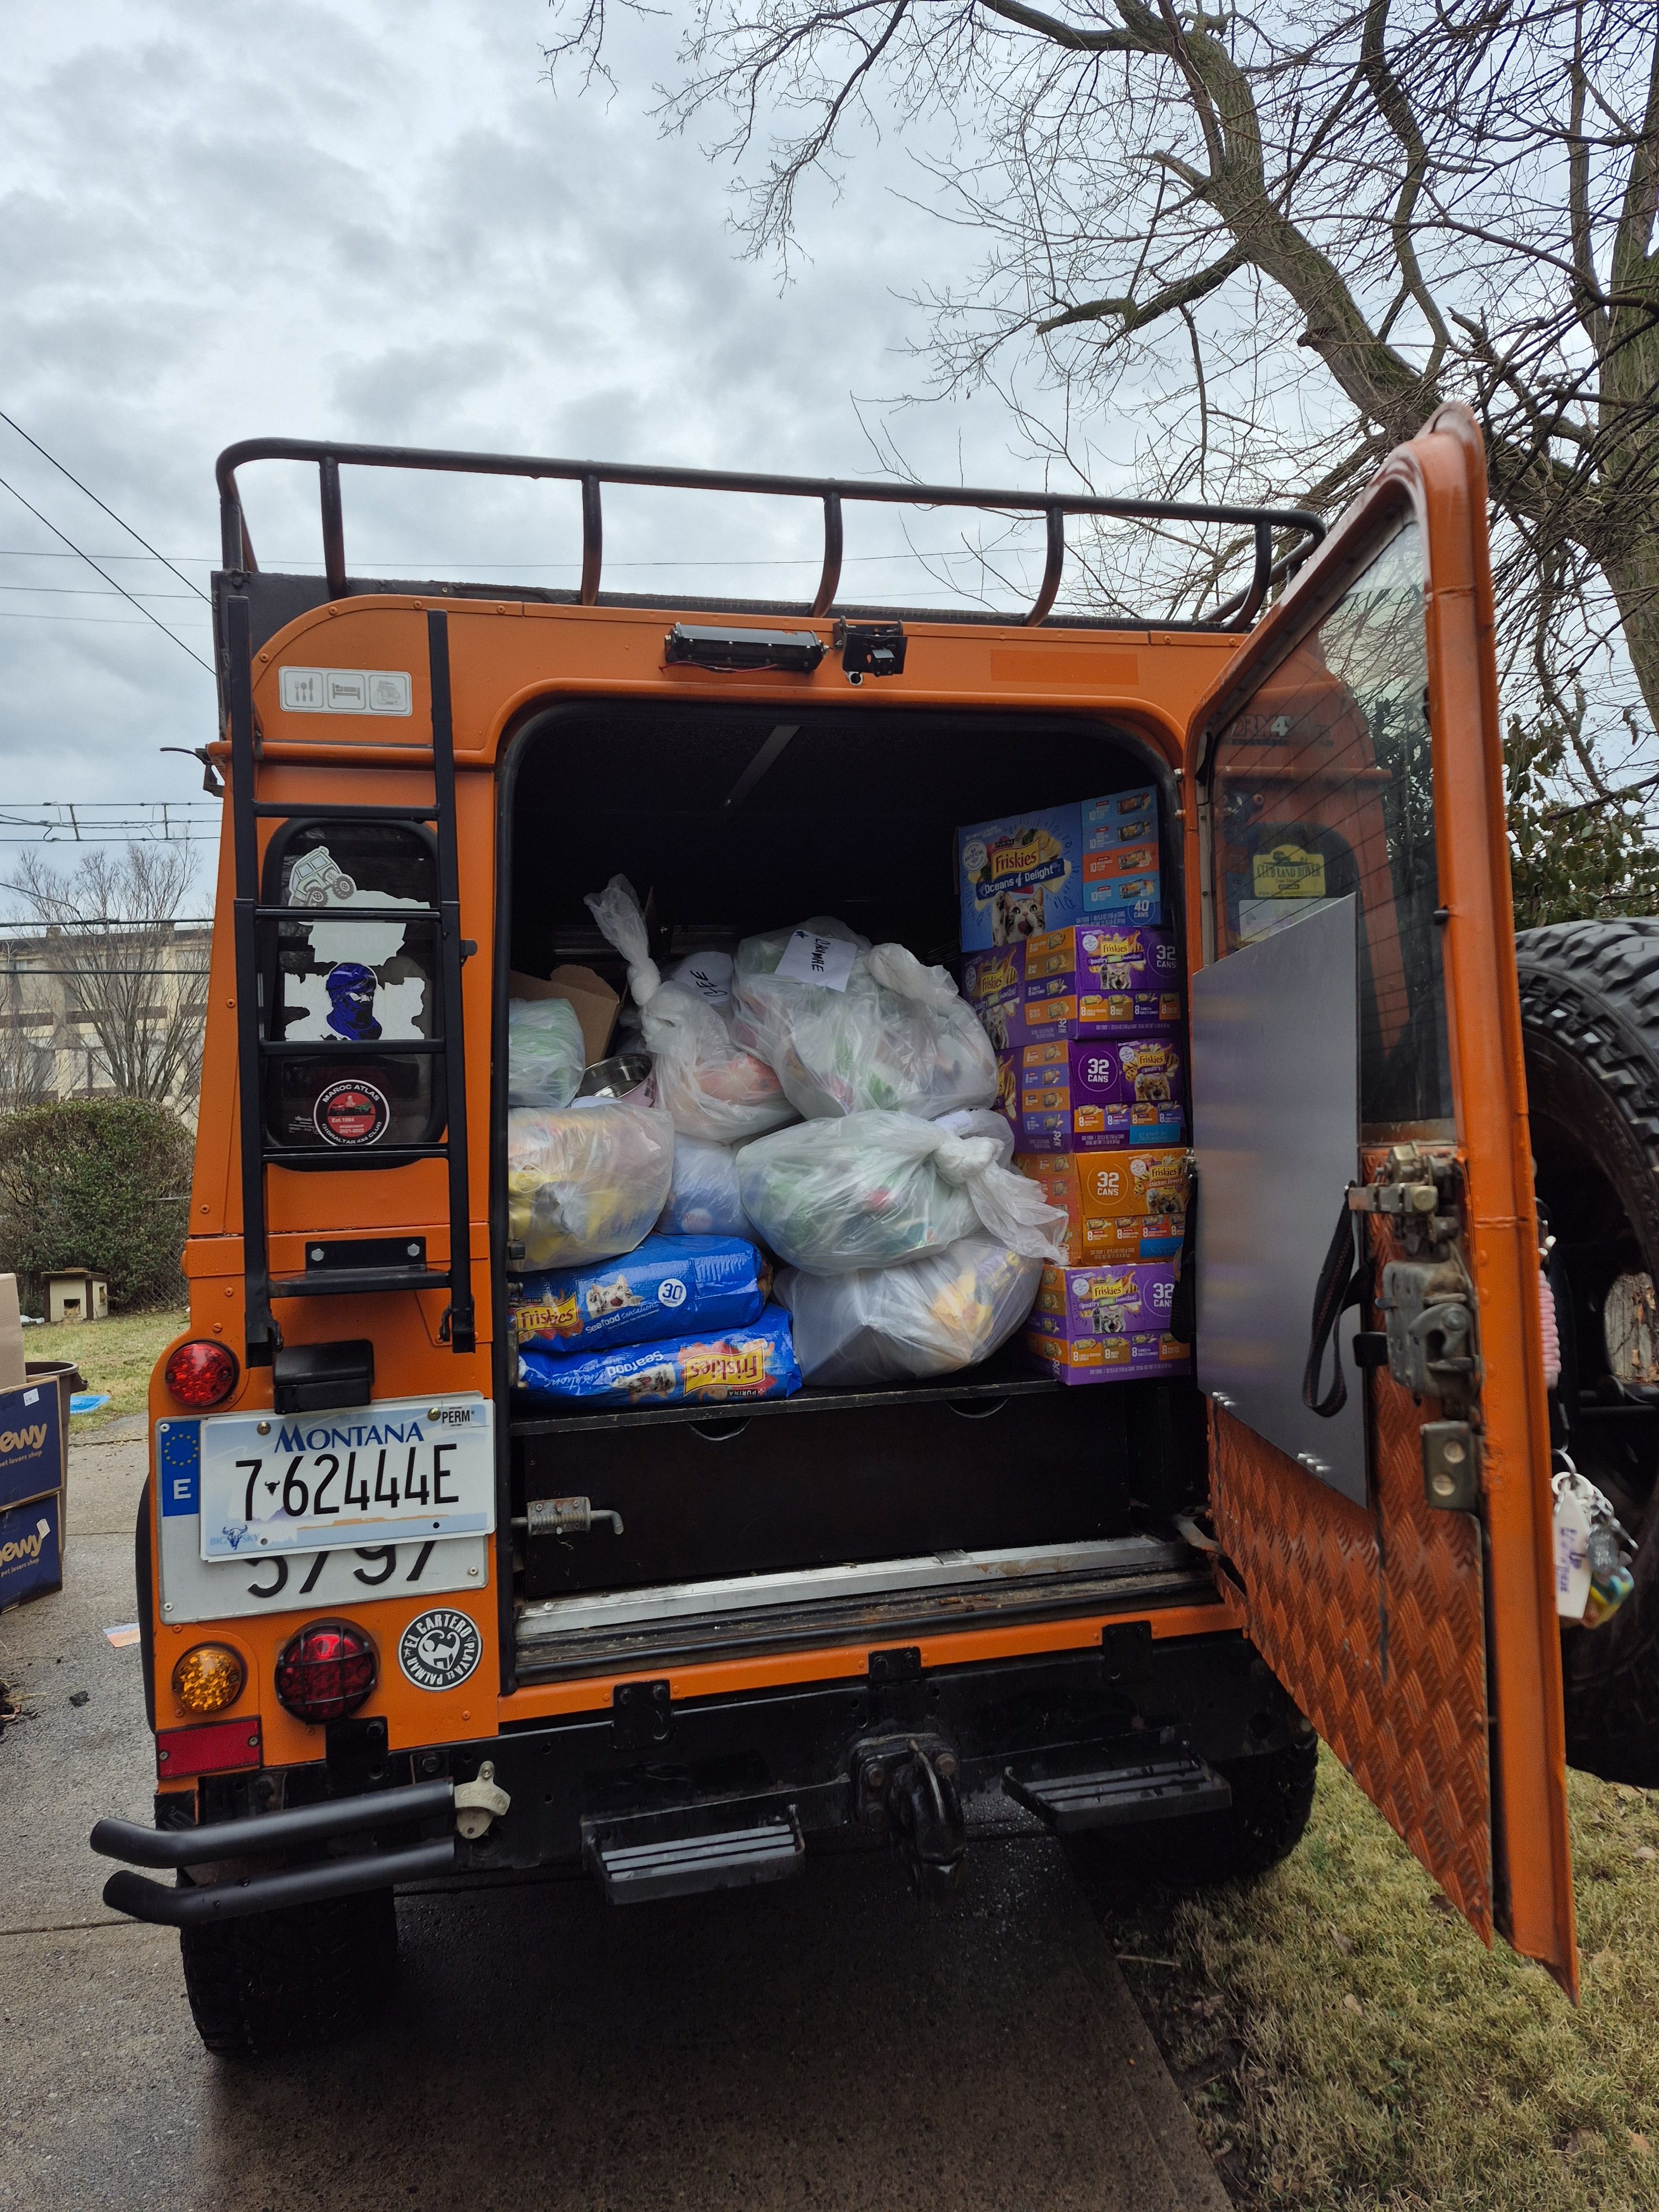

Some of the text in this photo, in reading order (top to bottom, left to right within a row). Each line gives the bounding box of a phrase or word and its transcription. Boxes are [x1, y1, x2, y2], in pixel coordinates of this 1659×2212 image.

[1089, 839, 1096, 849] 10
[995, 851, 1037, 873] Friskies
[1090, 863, 1097, 873] 10
[1257, 863, 1322, 878] CLUB LAND ROVER
[985, 878, 1014, 894] Oceans
[1025, 867, 1054, 883] Delight
[1091, 891, 1097, 901] 10
[1134, 900, 1149, 911] 40
[1103, 945, 1128, 953] Friskies
[1156, 945, 1176, 961] 32
[982, 975, 1002, 990] Friskies
[1081, 1006, 1086, 1016] 8
[1110, 1005, 1115, 1015] 8
[1135, 1005, 1140, 1015] 8
[1162, 1005, 1166, 1014] 8
[1058, 1018, 1066, 1028] 32
[1140, 1055, 1163, 1065] Friskies
[1088, 1058, 1109, 1075] 32
[1088, 1074, 1109, 1083] CANS
[322, 1084, 380, 1103] MAROC ATLAS
[1079, 1117, 1084, 1126] 8
[1107, 1115, 1113, 1125] 8
[1133, 1114, 1138, 1124] 8
[1159, 1113, 1164, 1123] 8
[322, 1123, 356, 1144] GIBRALTAR
[368, 1121, 382, 1138] CLUB
[1053, 1130, 1061, 1141] 32
[1152, 1168, 1177, 1177] Friskies
[1097, 1171, 1119, 1188] 32
[1097, 1188, 1119, 1196] CANS
[1117, 1229, 1122, 1239] 8
[1143, 1228, 1148, 1237] 8
[1171, 1225, 1176, 1235] 8
[1087, 1231, 1093, 1241] 8
[662, 1283, 684, 1300] 30
[1094, 1286, 1121, 1297] Friskies
[1152, 1282, 1175, 1299] 32
[1082, 1301, 1099, 1310] poultry
[520, 1307, 575, 1328] Friskies
[585, 1313, 620, 1334] Seafood
[621, 1301, 659, 1319] sensations
[1105, 1349, 1110, 1359] 8
[1132, 1347, 1138, 1357] 8
[1162, 1345, 1167, 1354] 8
[1073, 1351, 1078, 1361] 8
[606, 1351, 664, 1378] Seafood
[691, 1355, 757, 1380] Friskies
[442, 1410, 470, 1424] PERM
[0, 1423, 48, 1453] ewy
[274, 1422, 424, 1454] MONTANA
[9, 1454, 27, 1465] lovers
[28, 1450, 43, 1459] shop
[173, 1479, 191, 1500] E
[210, 1533, 260, 1545] BIG SKY
[0, 1535, 43, 1567] ewy
[1, 1557, 39, 1578] pet lovers shop
[404, 1614, 473, 1648] EL CARTERO
[406, 1642, 475, 1685] PLAYA EL PALMAR
